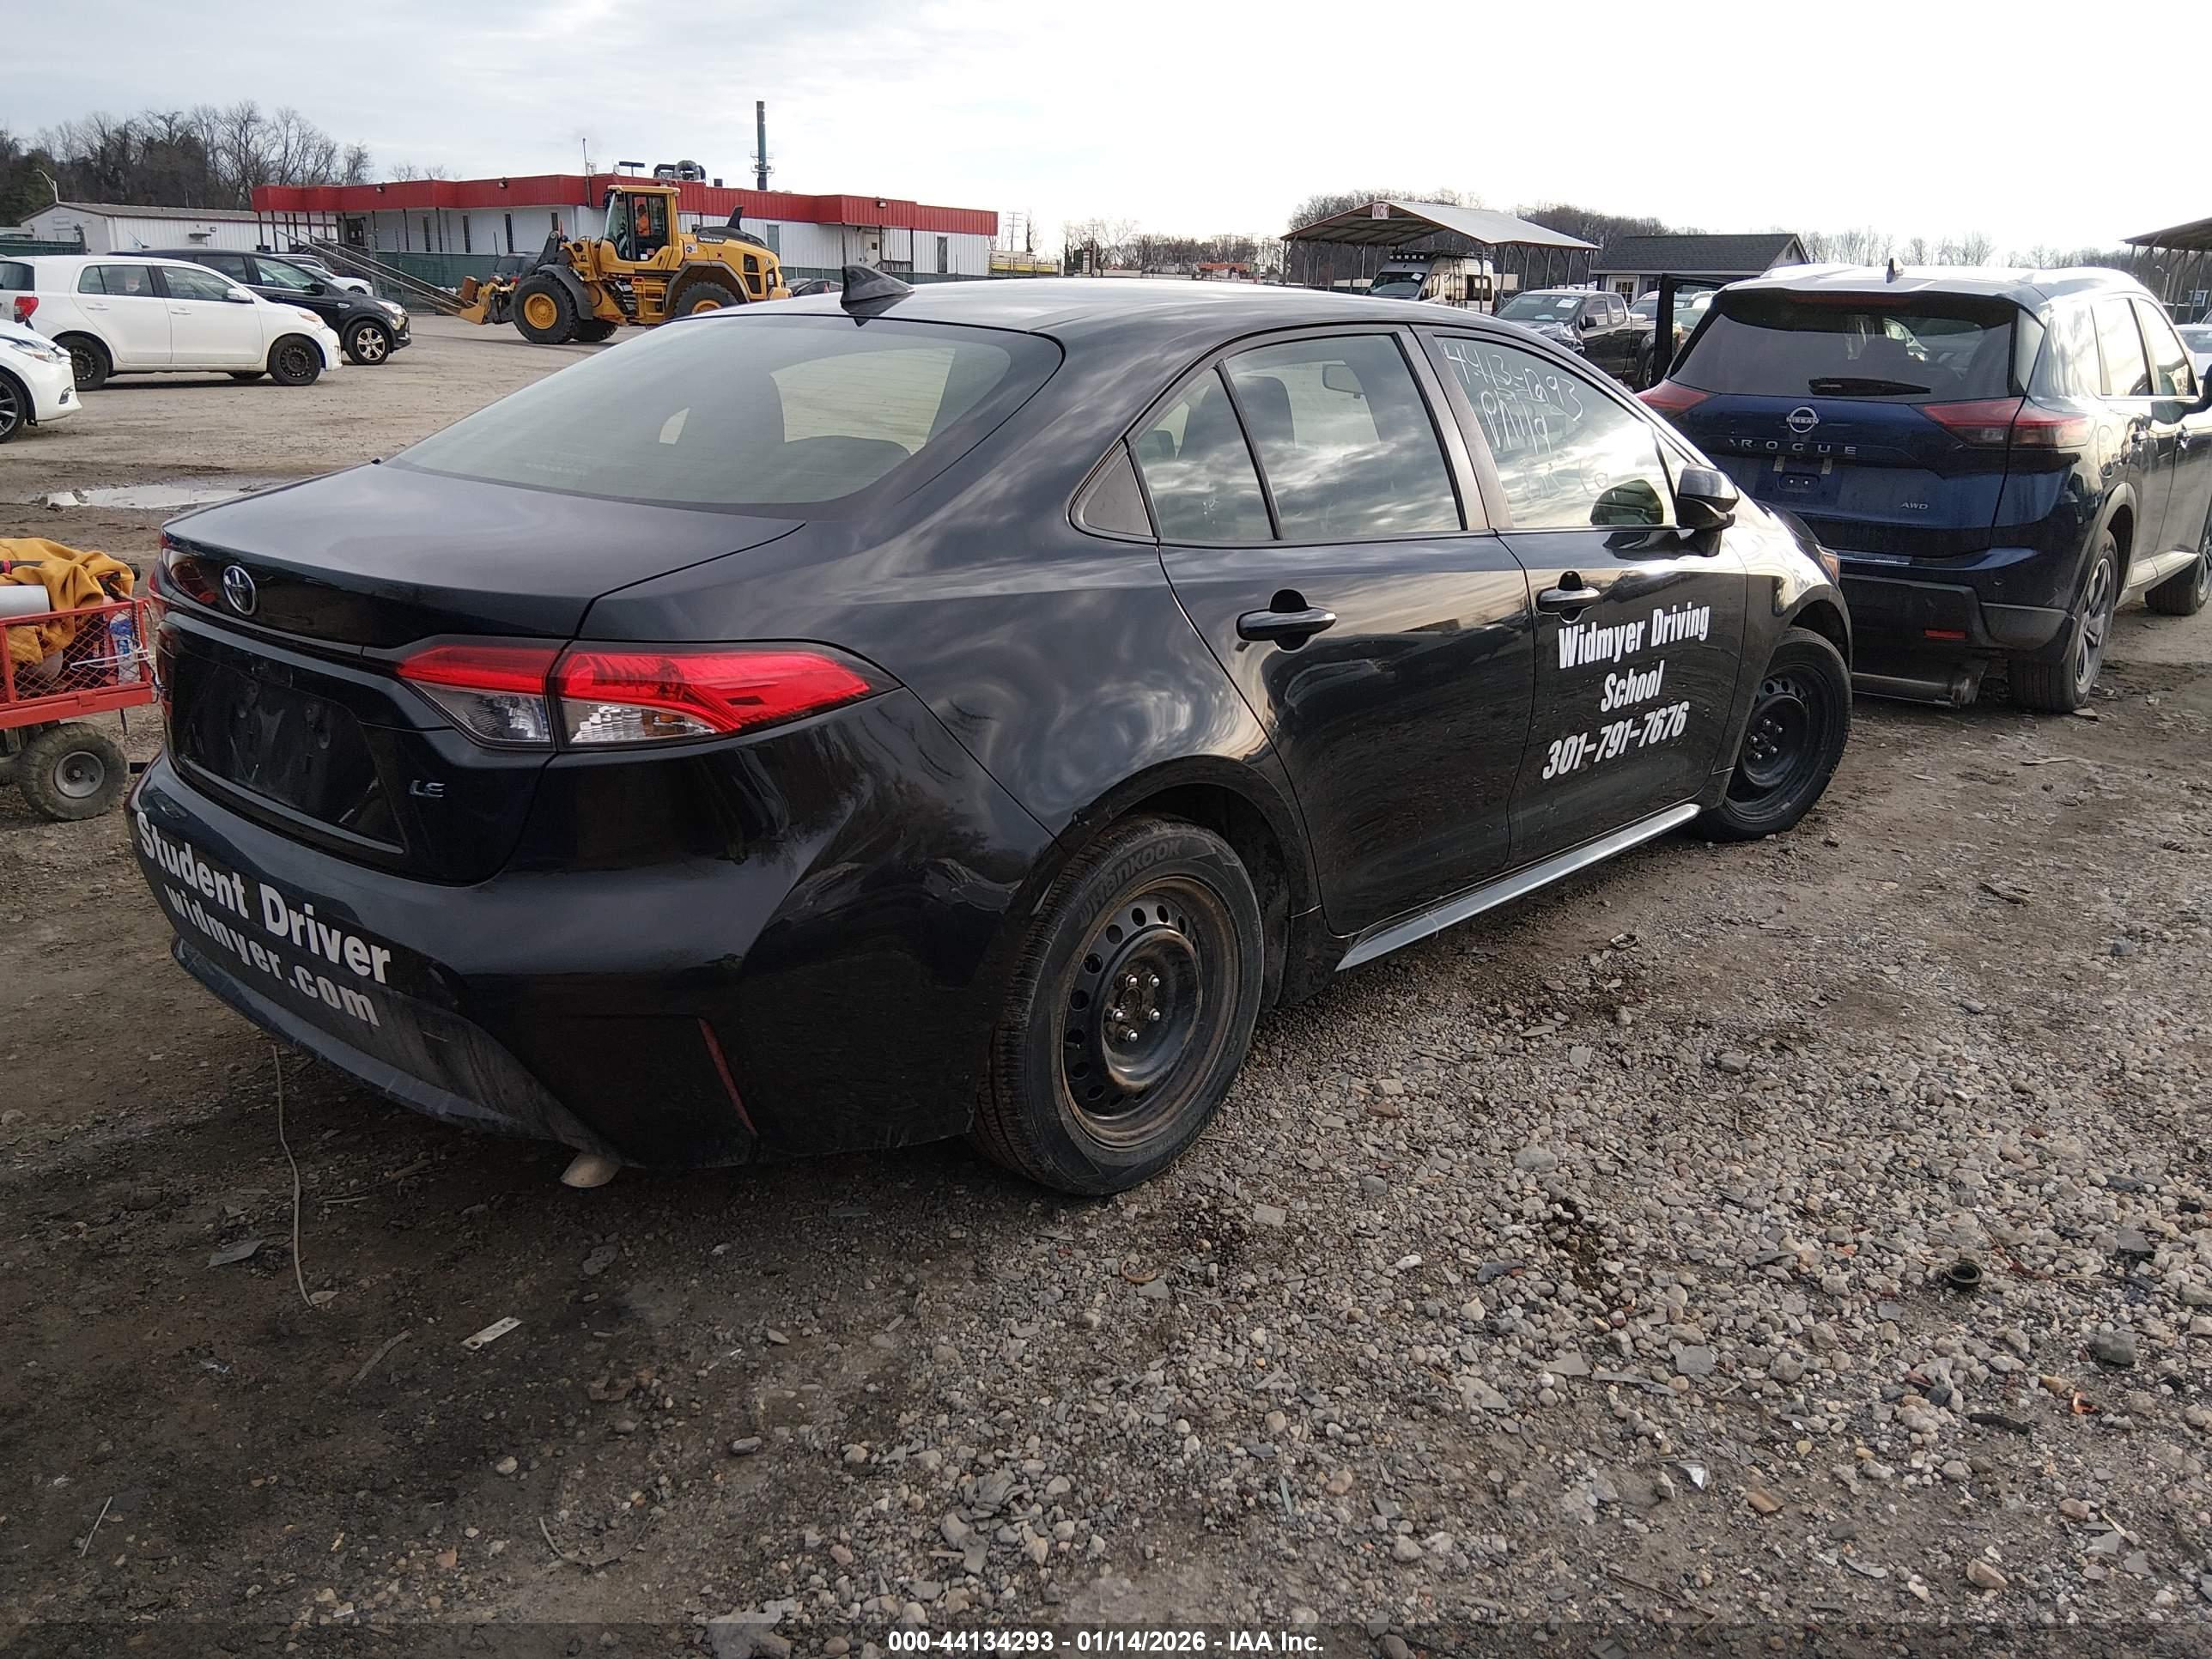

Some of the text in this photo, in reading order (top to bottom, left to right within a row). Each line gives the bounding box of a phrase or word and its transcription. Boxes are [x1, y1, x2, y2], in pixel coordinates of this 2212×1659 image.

[1374, 205, 1383, 217] VIC
[1786, 416, 1819, 425] NISSAN
[1741, 439, 1856, 455] ROGUE
[1901, 501, 1929, 510] AWD
[1559, 602, 1711, 670] Widmyer Driving
[1601, 660, 1665, 713] School
[1542, 701, 1690, 780] 301-791-7676
[410, 780, 445, 797] LE
[137, 811, 392, 984] Student Driver
